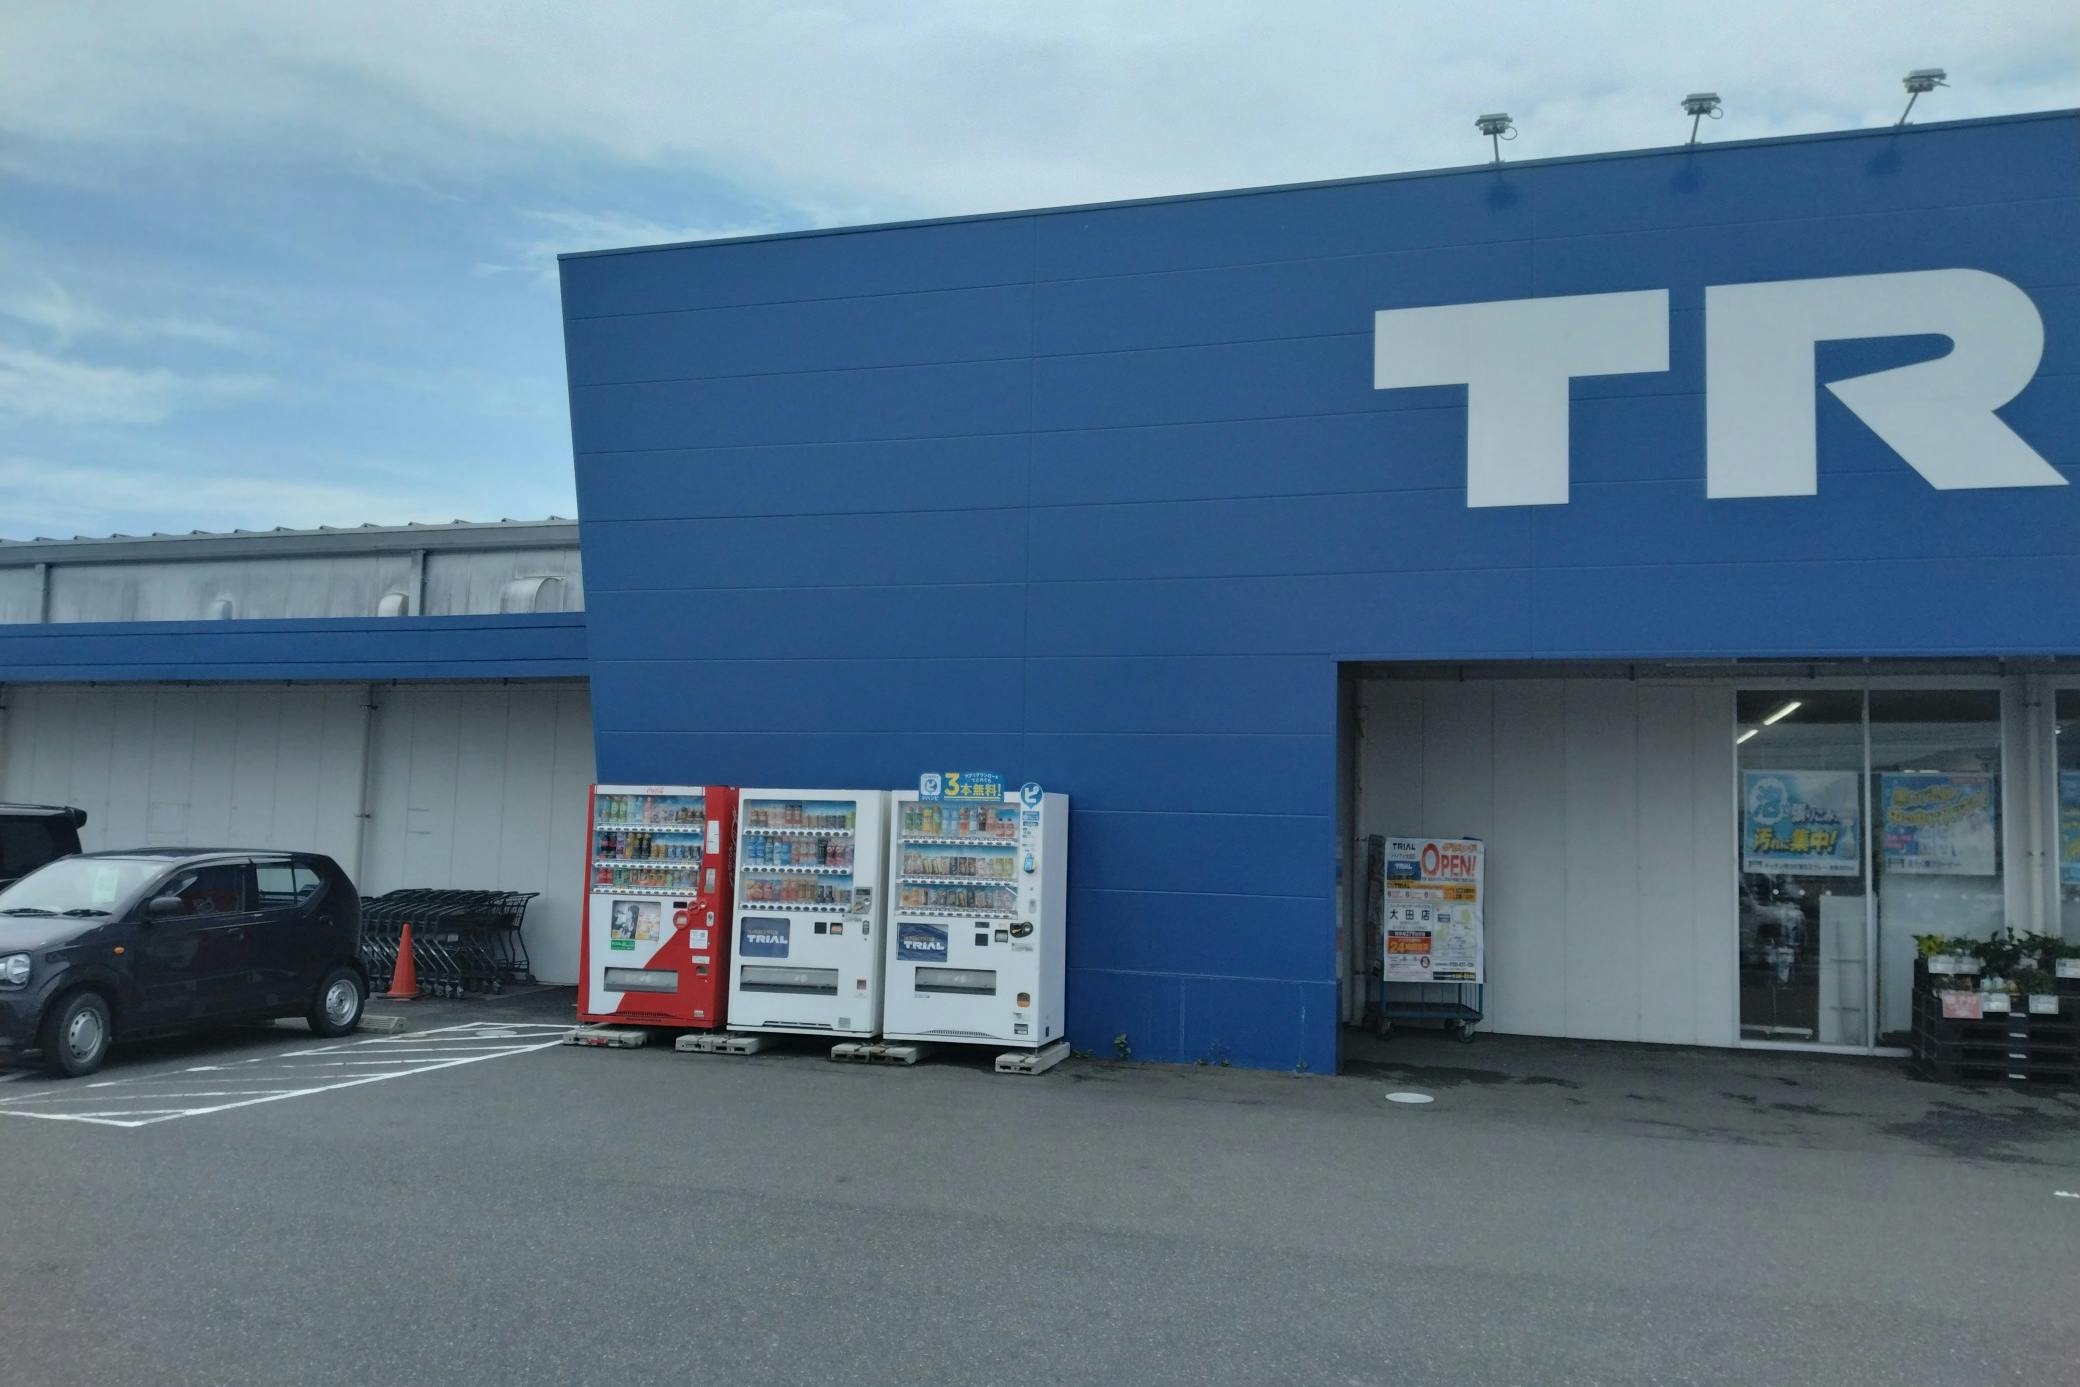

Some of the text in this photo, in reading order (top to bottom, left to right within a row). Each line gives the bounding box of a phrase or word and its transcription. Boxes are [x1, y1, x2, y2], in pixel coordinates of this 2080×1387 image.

[1374, 268, 2070, 508] TR
[1024, 786, 1039, 803] ピ
[1393, 842, 1416, 851] TRIAL
[1421, 842, 1477, 877] OPEN!
[746, 934, 788, 944] TRIAL
[903, 940, 945, 951] TRIAL
